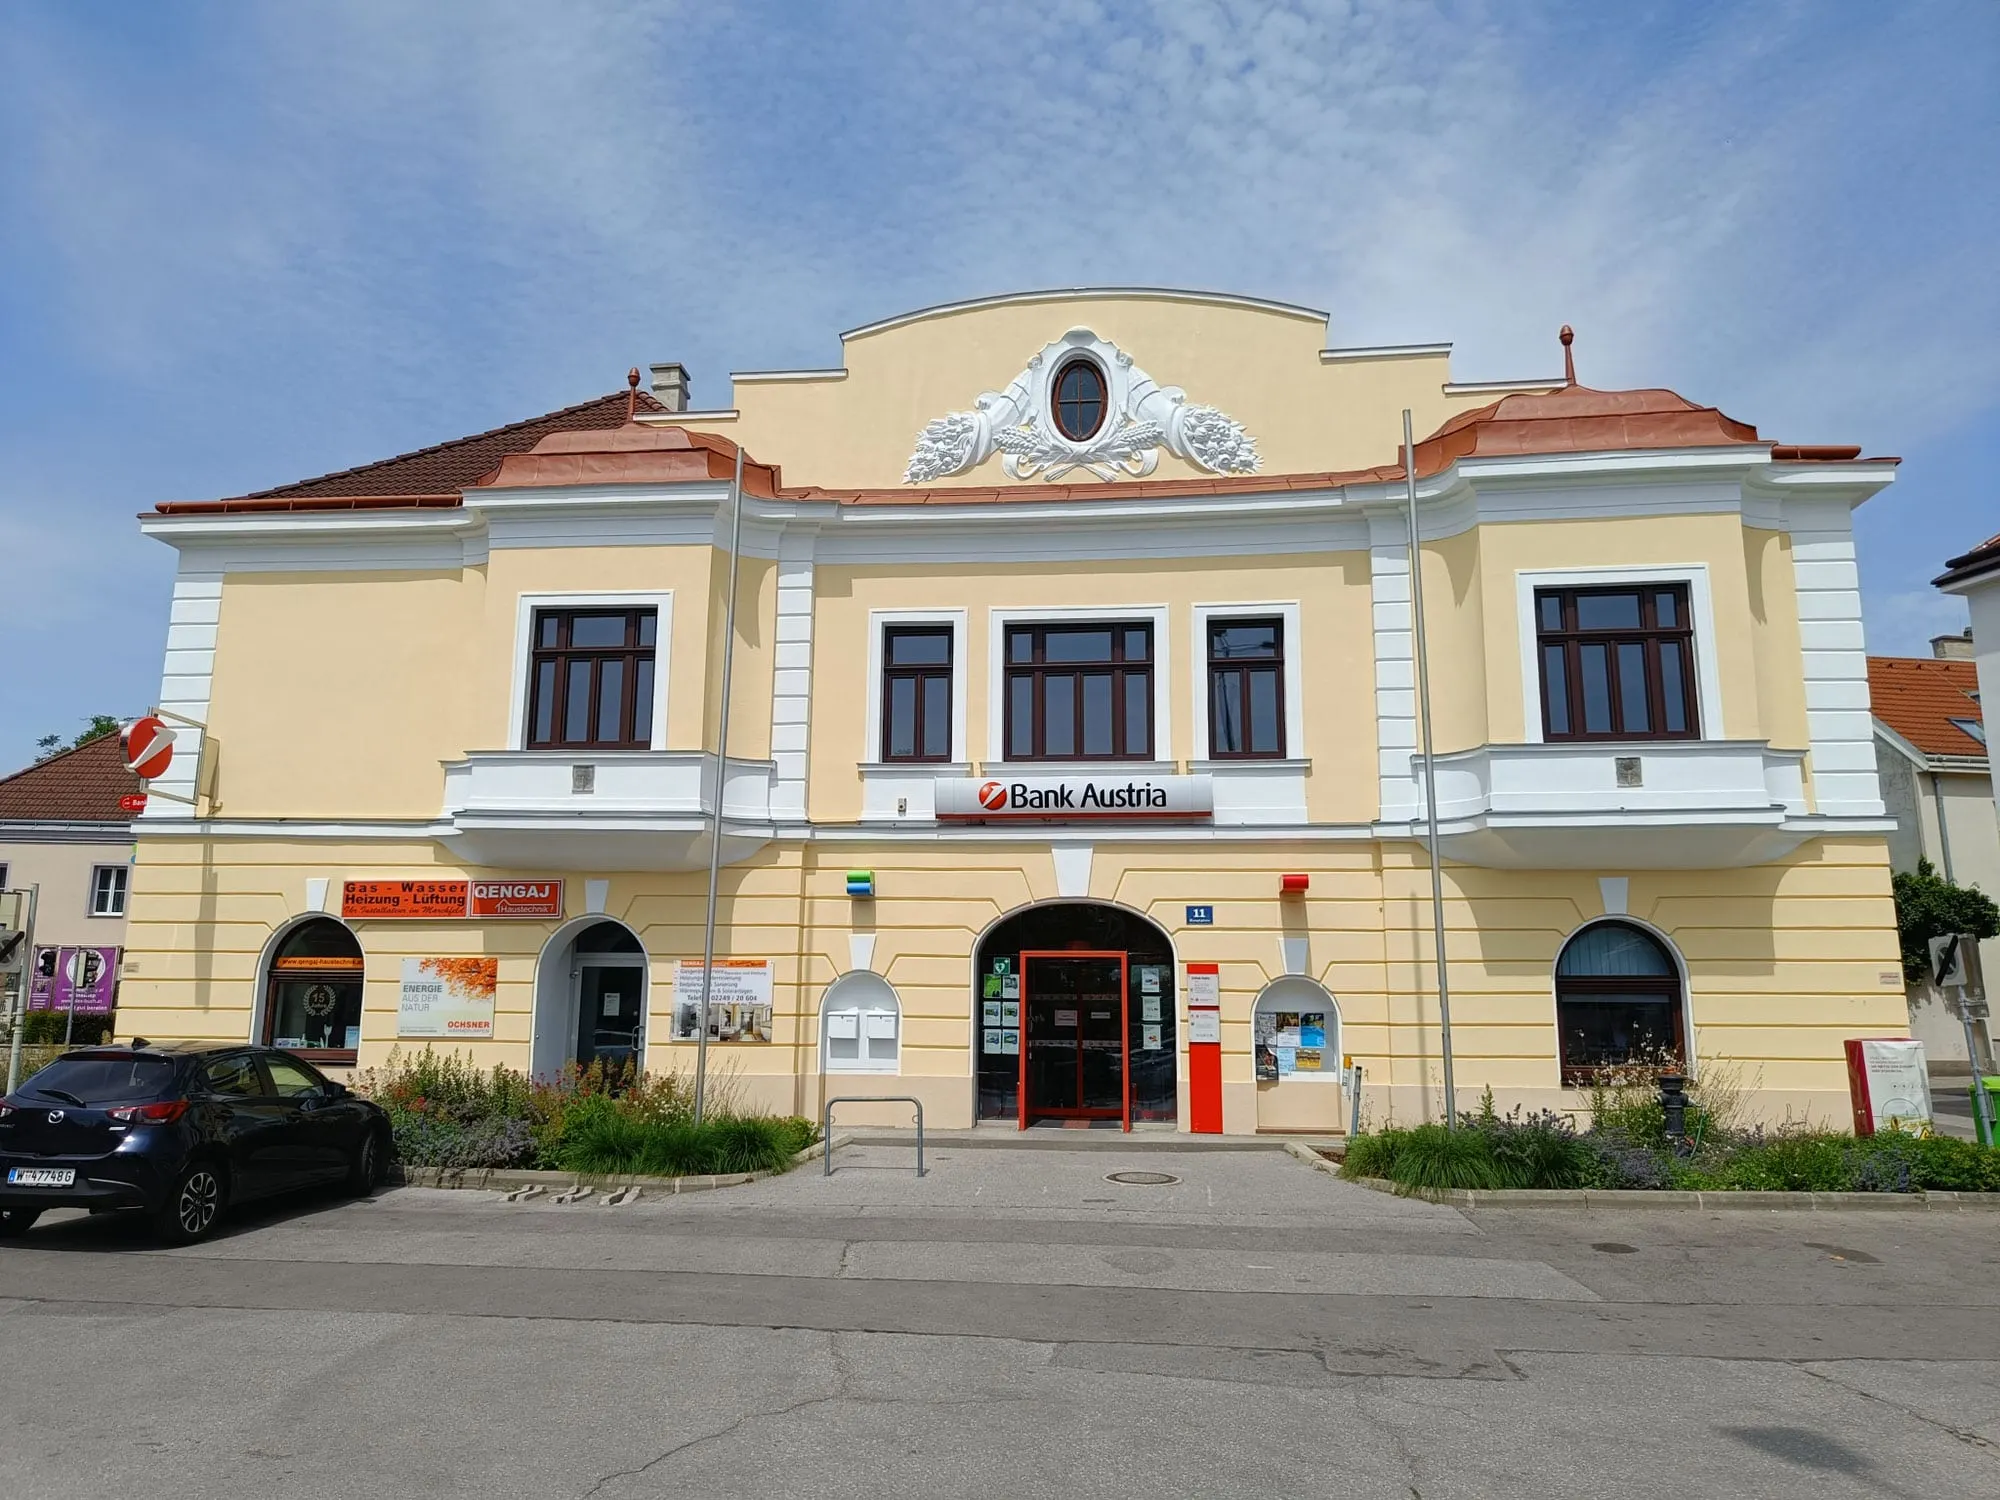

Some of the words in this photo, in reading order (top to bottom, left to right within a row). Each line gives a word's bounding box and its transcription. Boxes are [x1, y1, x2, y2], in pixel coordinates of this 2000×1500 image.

[1011, 783, 1075, 809] Bank
[1080, 782, 1167, 808] Austria
[345, 883, 378, 893] Gas
[401, 882, 466, 893] Wasser
[474, 885, 550, 899] QENGAJ
[345, 894, 400, 907] Heizung
[413, 894, 465, 907] Lüftung
[500, 904, 549, 913] Haustechnik
[1193, 908, 1206, 918] 11
[403, 984, 443, 993] ENERGIE
[312, 993, 325, 1003] 15
[402, 994, 419, 1002] AUS
[421, 994, 438, 1002] DER
[401, 1003, 430, 1012] NATUR
[447, 1021, 490, 1029] OCHSNER
